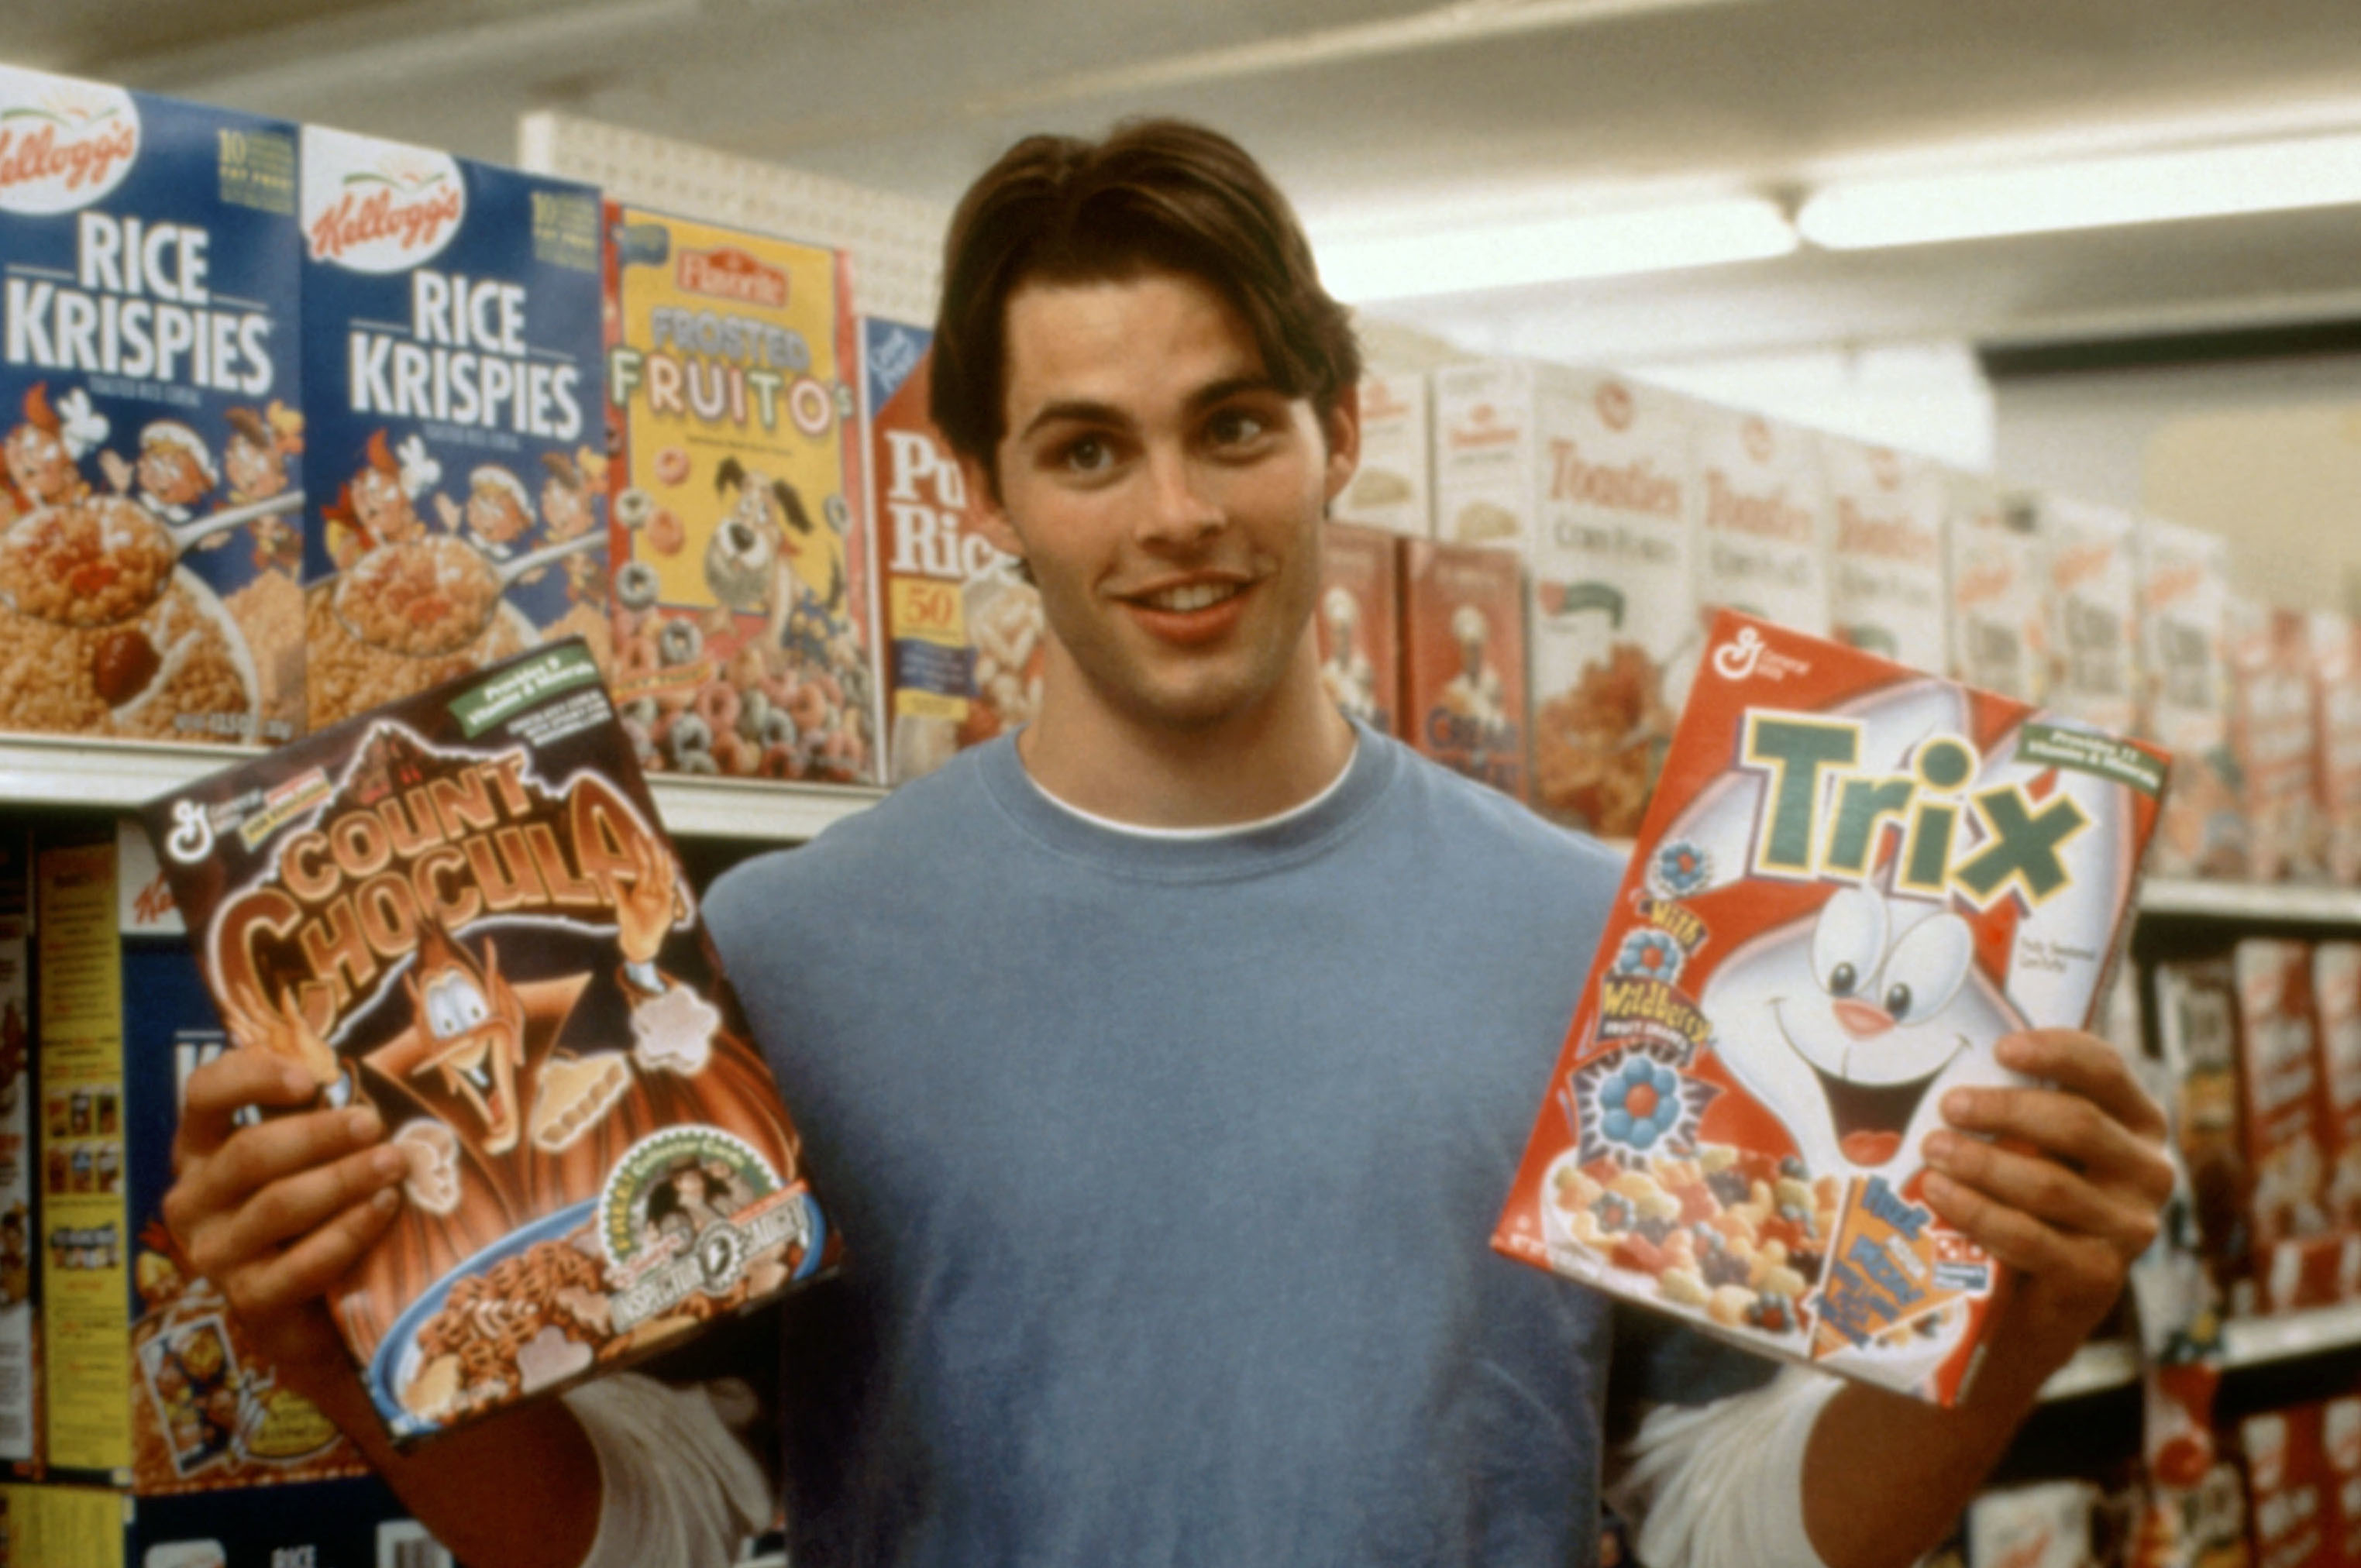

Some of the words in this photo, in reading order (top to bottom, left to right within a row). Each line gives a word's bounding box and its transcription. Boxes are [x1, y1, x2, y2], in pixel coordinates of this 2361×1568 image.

[0, 122, 134, 192] ellogg's
[79, 212, 208, 304] RICE
[311, 185, 460, 256] Kellogg's
[6, 278, 273, 395] KRISPIES
[411, 270, 525, 356] RICE
[652, 304, 811, 372] FROSTED
[349, 332, 581, 441] KRISPIES
[887, 504, 996, 583] Ric
[905, 586, 953, 628] 50
[281, 751, 532, 901] COUNT
[1744, 711, 2092, 910] Trix
[215, 775, 690, 1044] CHOCULA
[1602, 979, 1713, 1044] Wildberry
